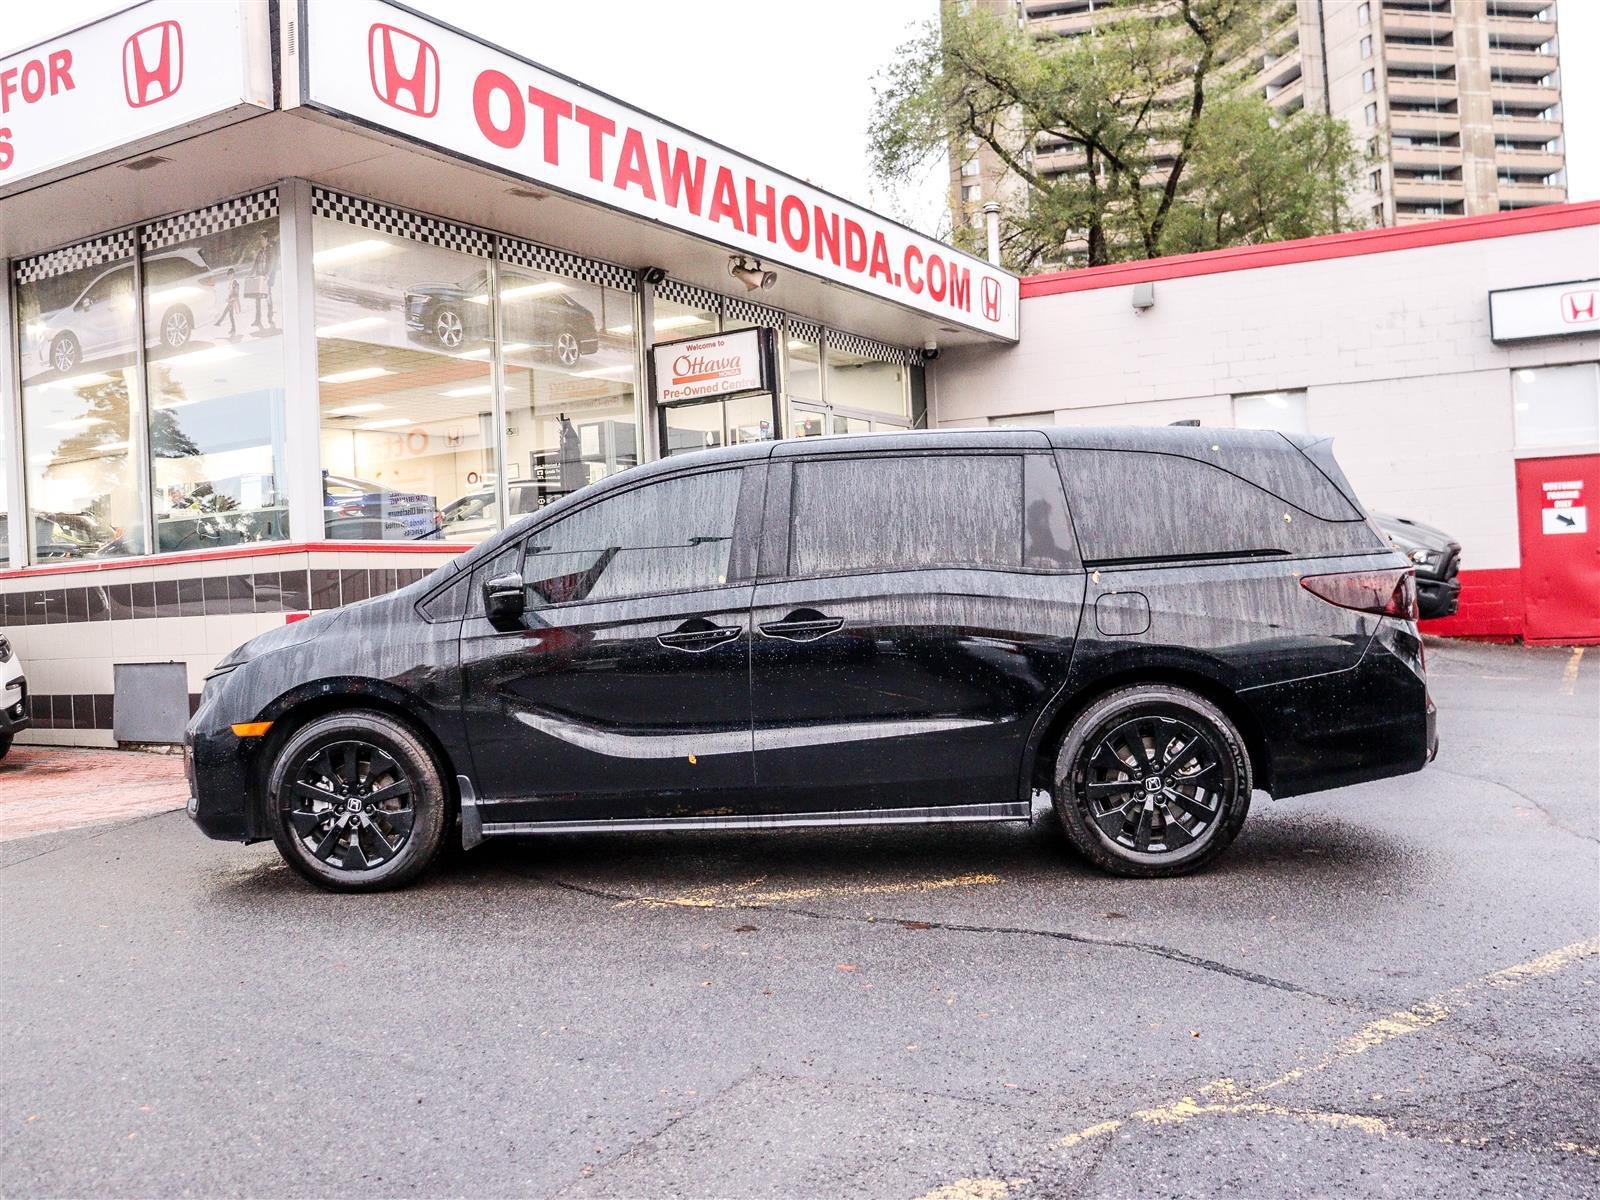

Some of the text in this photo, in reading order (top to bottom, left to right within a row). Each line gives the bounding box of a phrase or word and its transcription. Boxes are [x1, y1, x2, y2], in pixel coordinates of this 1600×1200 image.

[0, 48, 76, 114] FOR
[472, 69, 971, 313] OTTAWAHONDA.COM
[686, 339, 725, 352] Welcome to
[672, 354, 742, 377] Ottawa
[663, 381, 719, 400] Pre-Owned
